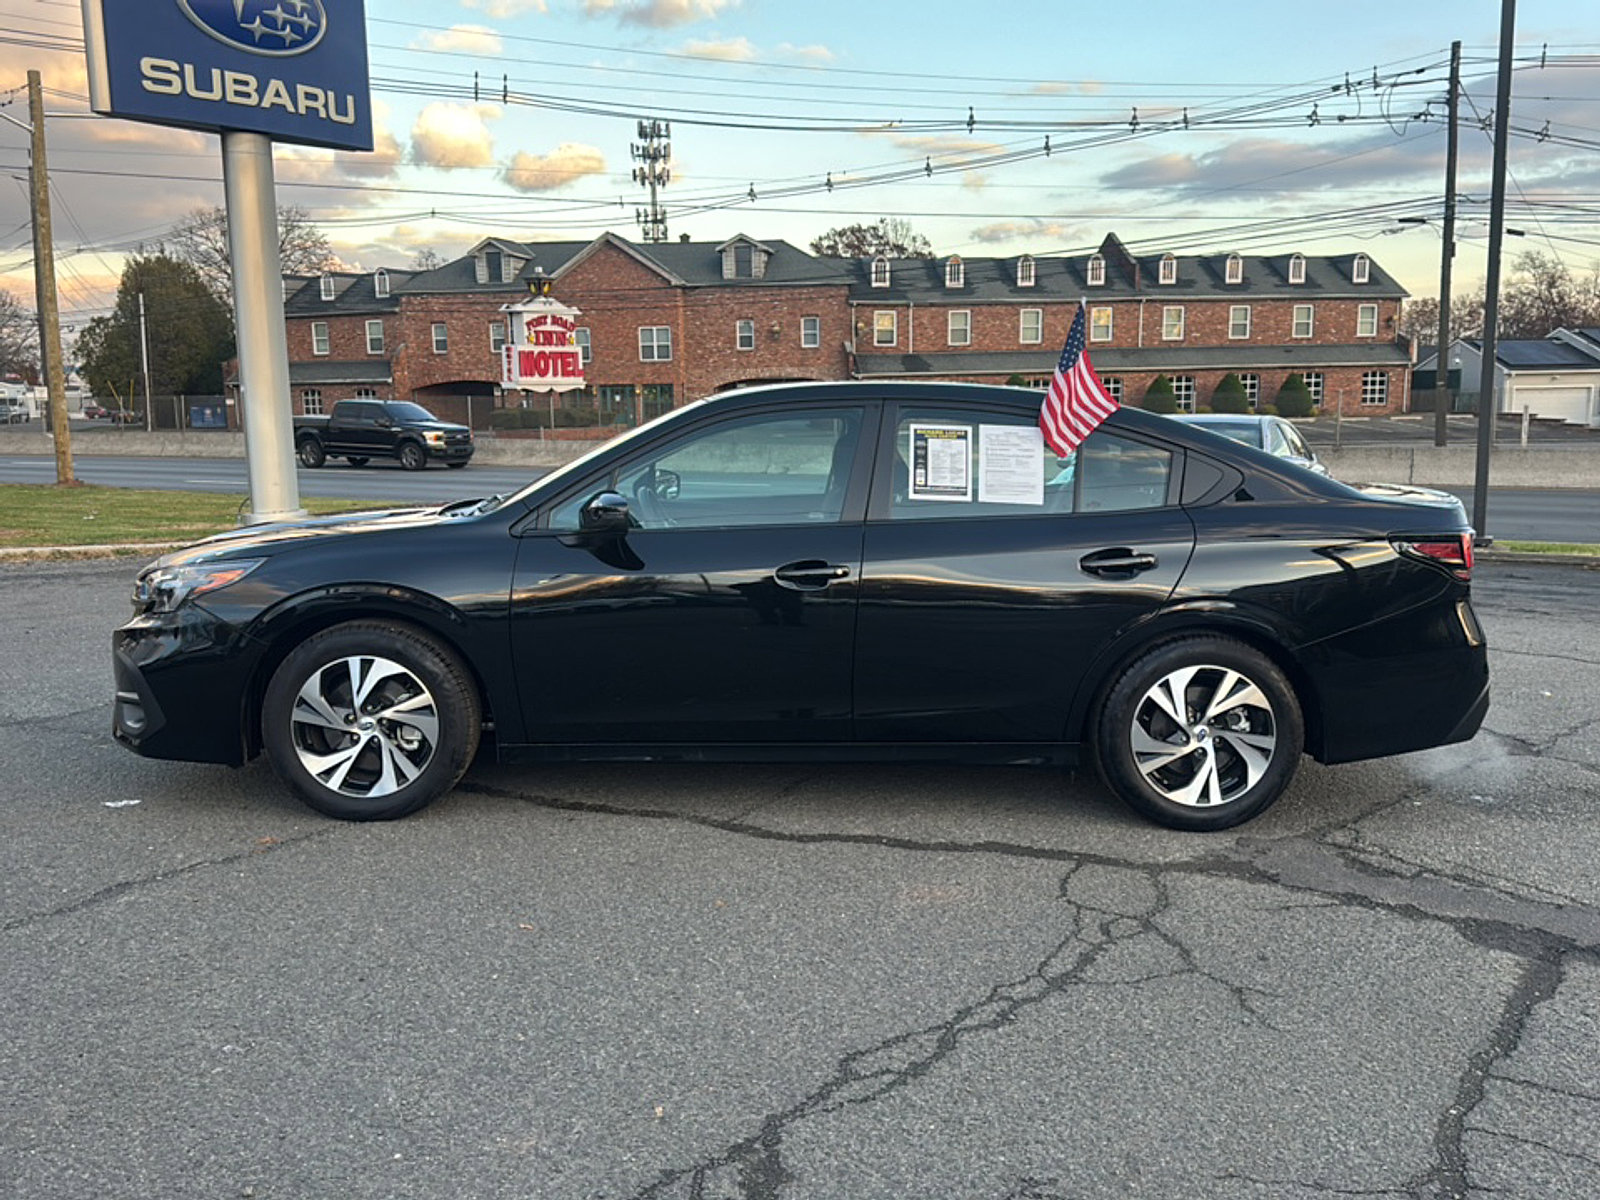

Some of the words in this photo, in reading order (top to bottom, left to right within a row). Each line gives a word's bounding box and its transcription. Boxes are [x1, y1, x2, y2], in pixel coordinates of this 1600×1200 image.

[139, 56, 355, 125] SUBARU
[550, 315, 575, 332] ROAD
[533, 330, 568, 346] INN
[518, 350, 585, 378] MOTEL
